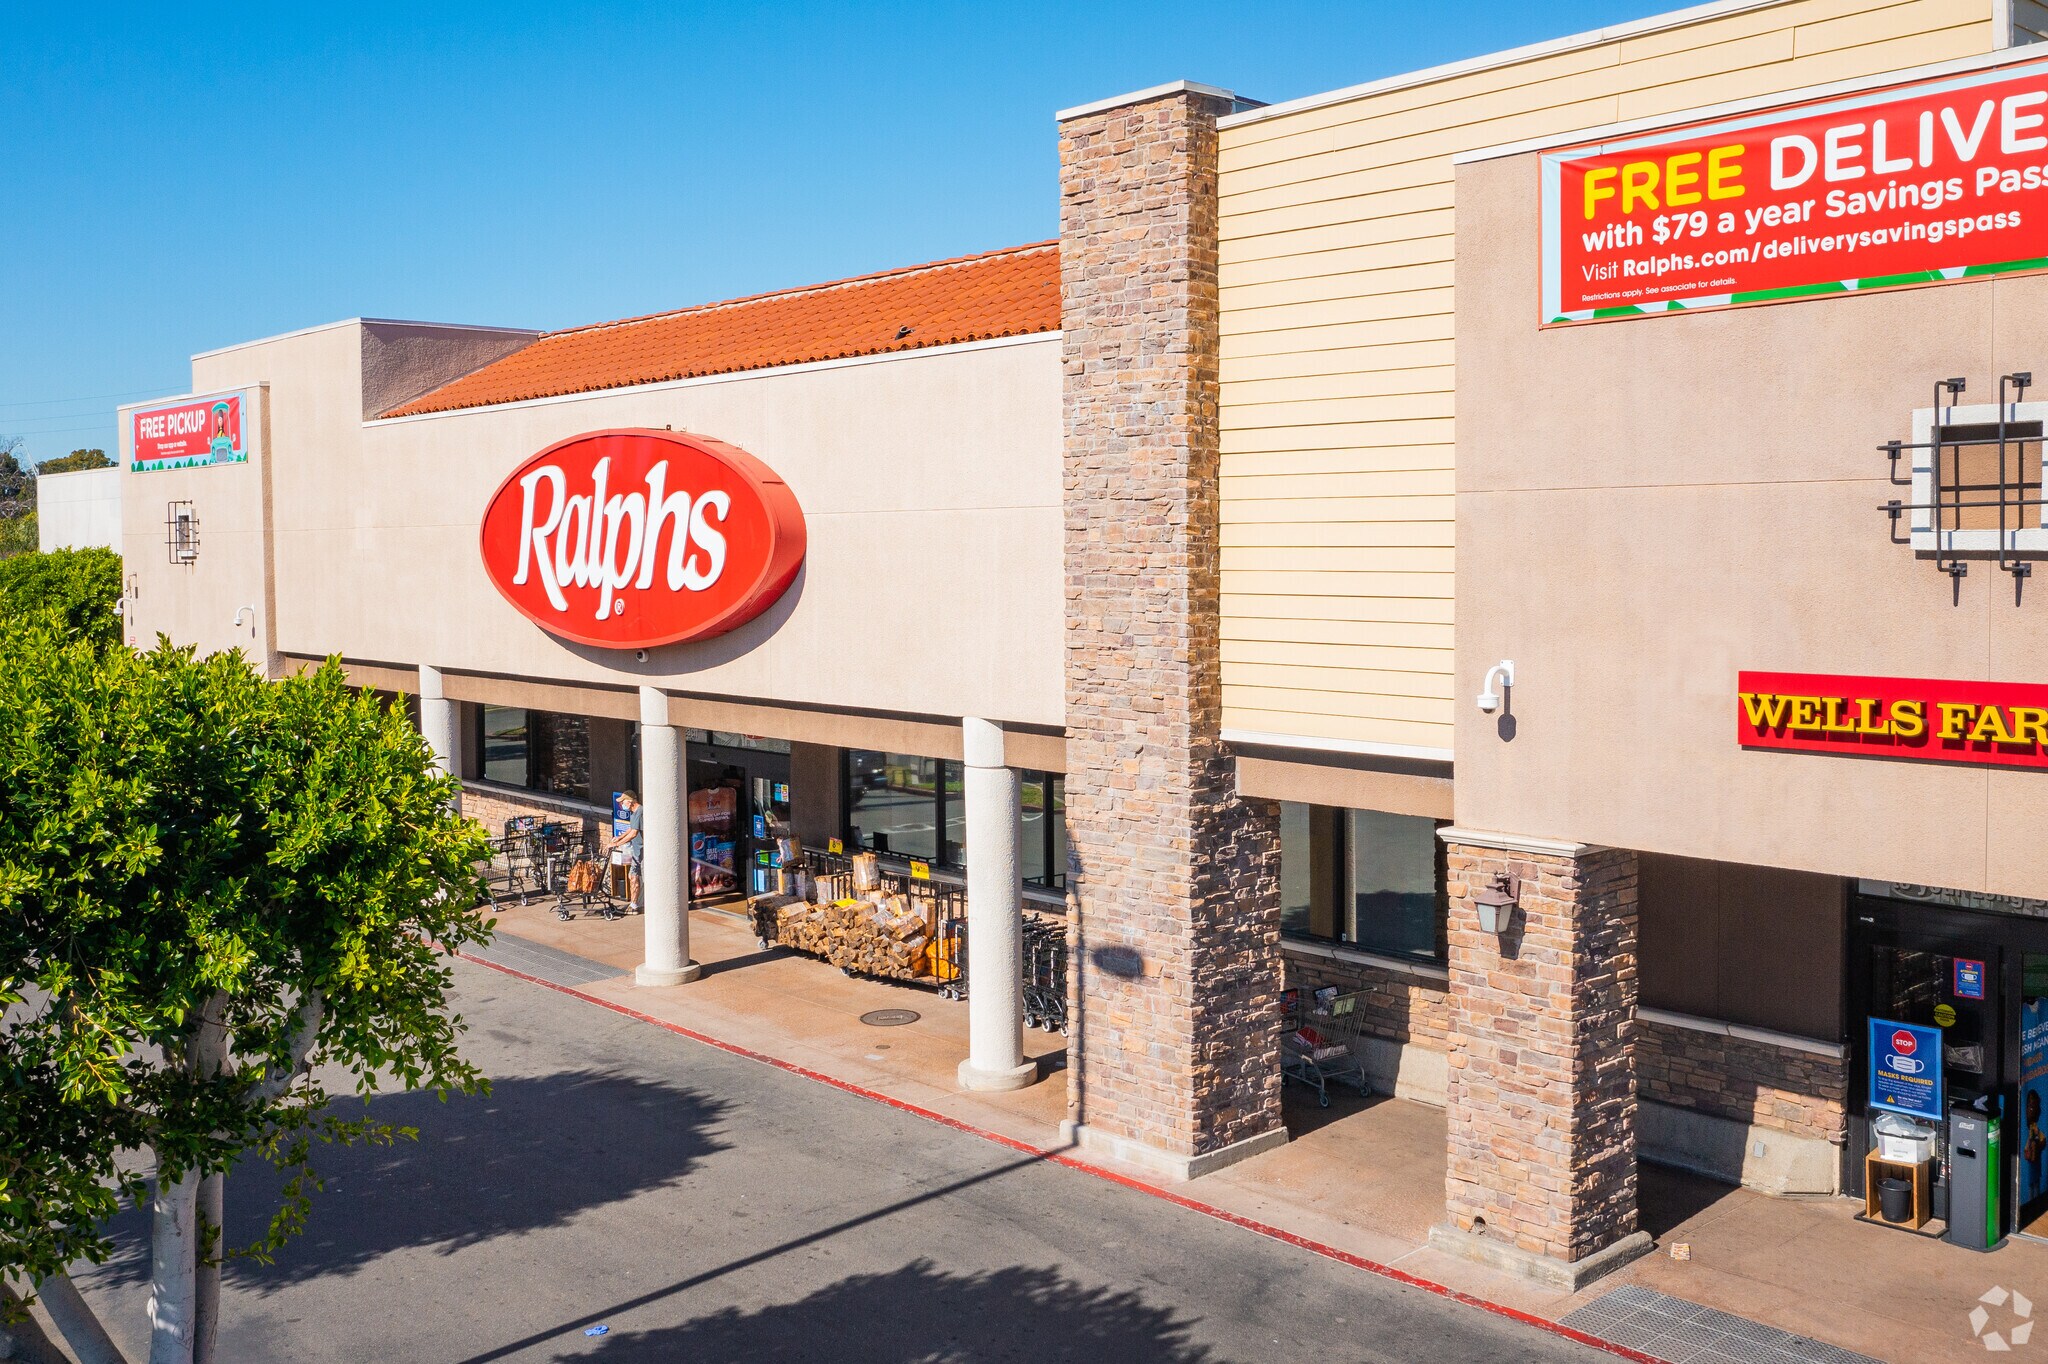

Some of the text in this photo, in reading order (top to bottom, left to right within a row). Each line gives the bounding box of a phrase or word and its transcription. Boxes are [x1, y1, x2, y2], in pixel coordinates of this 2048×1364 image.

[1584, 91, 2048, 220] FREE DELIVE
[1582, 220, 1643, 252] with
[1652, 210, 1708, 245] $79
[1717, 212, 1735, 233] a
[1744, 199, 1815, 235] year
[1826, 178, 1963, 217] Savings
[1582, 210, 2021, 281] Visit Ralphs.com/deliverysavingspass
[1582, 277, 1738, 302] Restrictions apply. See associate for details.
[140, 409, 206, 440] FREE PICKUP
[512, 456, 731, 621] Ralphs
[1738, 692, 2048, 745] WELLS FAR
[1895, 1039, 1913, 1047] STOP
[1878, 1069, 1934, 1086] MASKS REQUIRED
